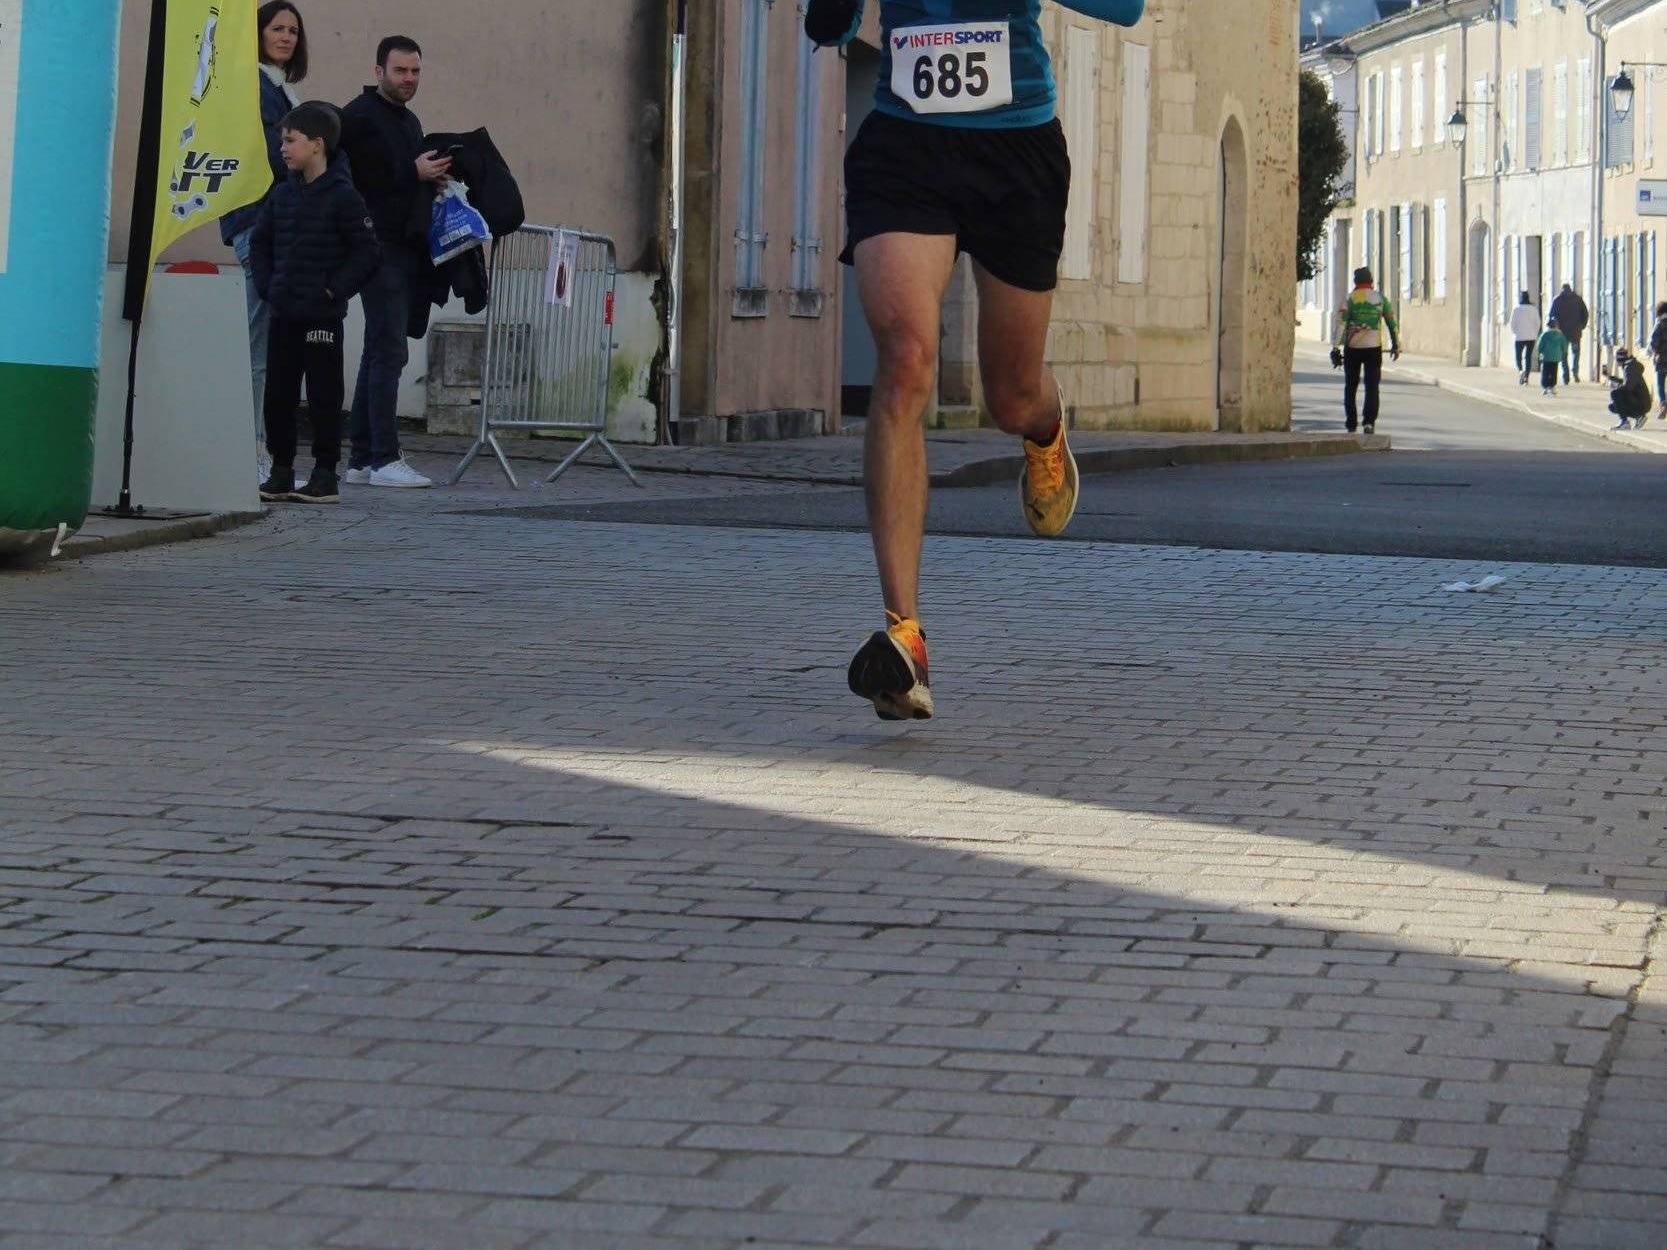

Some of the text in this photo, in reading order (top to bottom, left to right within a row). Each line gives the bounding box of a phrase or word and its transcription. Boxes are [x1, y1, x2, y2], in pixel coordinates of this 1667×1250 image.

[910, 30, 1003, 49] INTERSPORT
[913, 51, 989, 100] 685
[306, 329, 334, 343] SEATTLE
